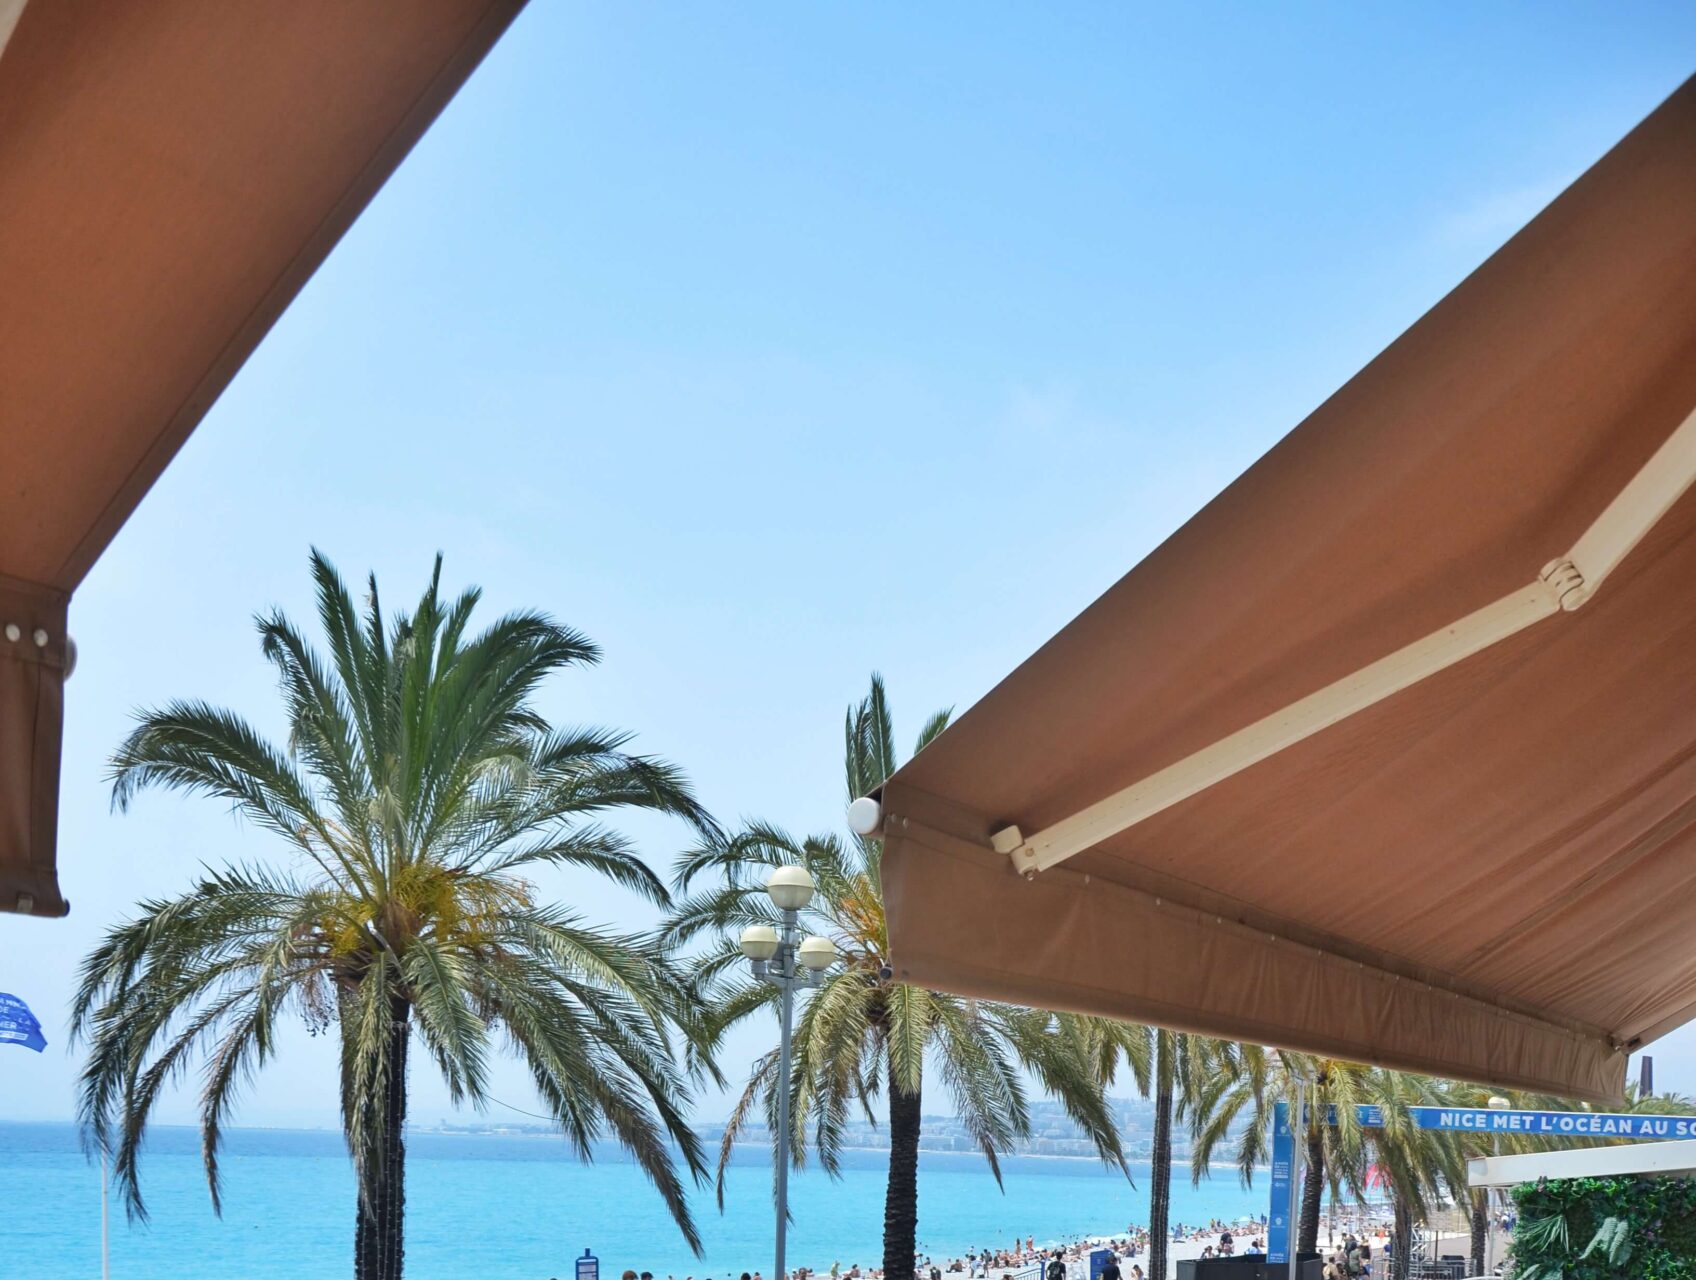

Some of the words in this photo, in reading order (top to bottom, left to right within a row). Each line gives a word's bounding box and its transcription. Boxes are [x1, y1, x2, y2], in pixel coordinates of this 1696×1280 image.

[1440, 1112, 1487, 1128] NICE
[1493, 1115, 1534, 1130] MET
[1541, 1114, 1632, 1134] L'OCÉAN
[1639, 1119, 1668, 1135] AU
